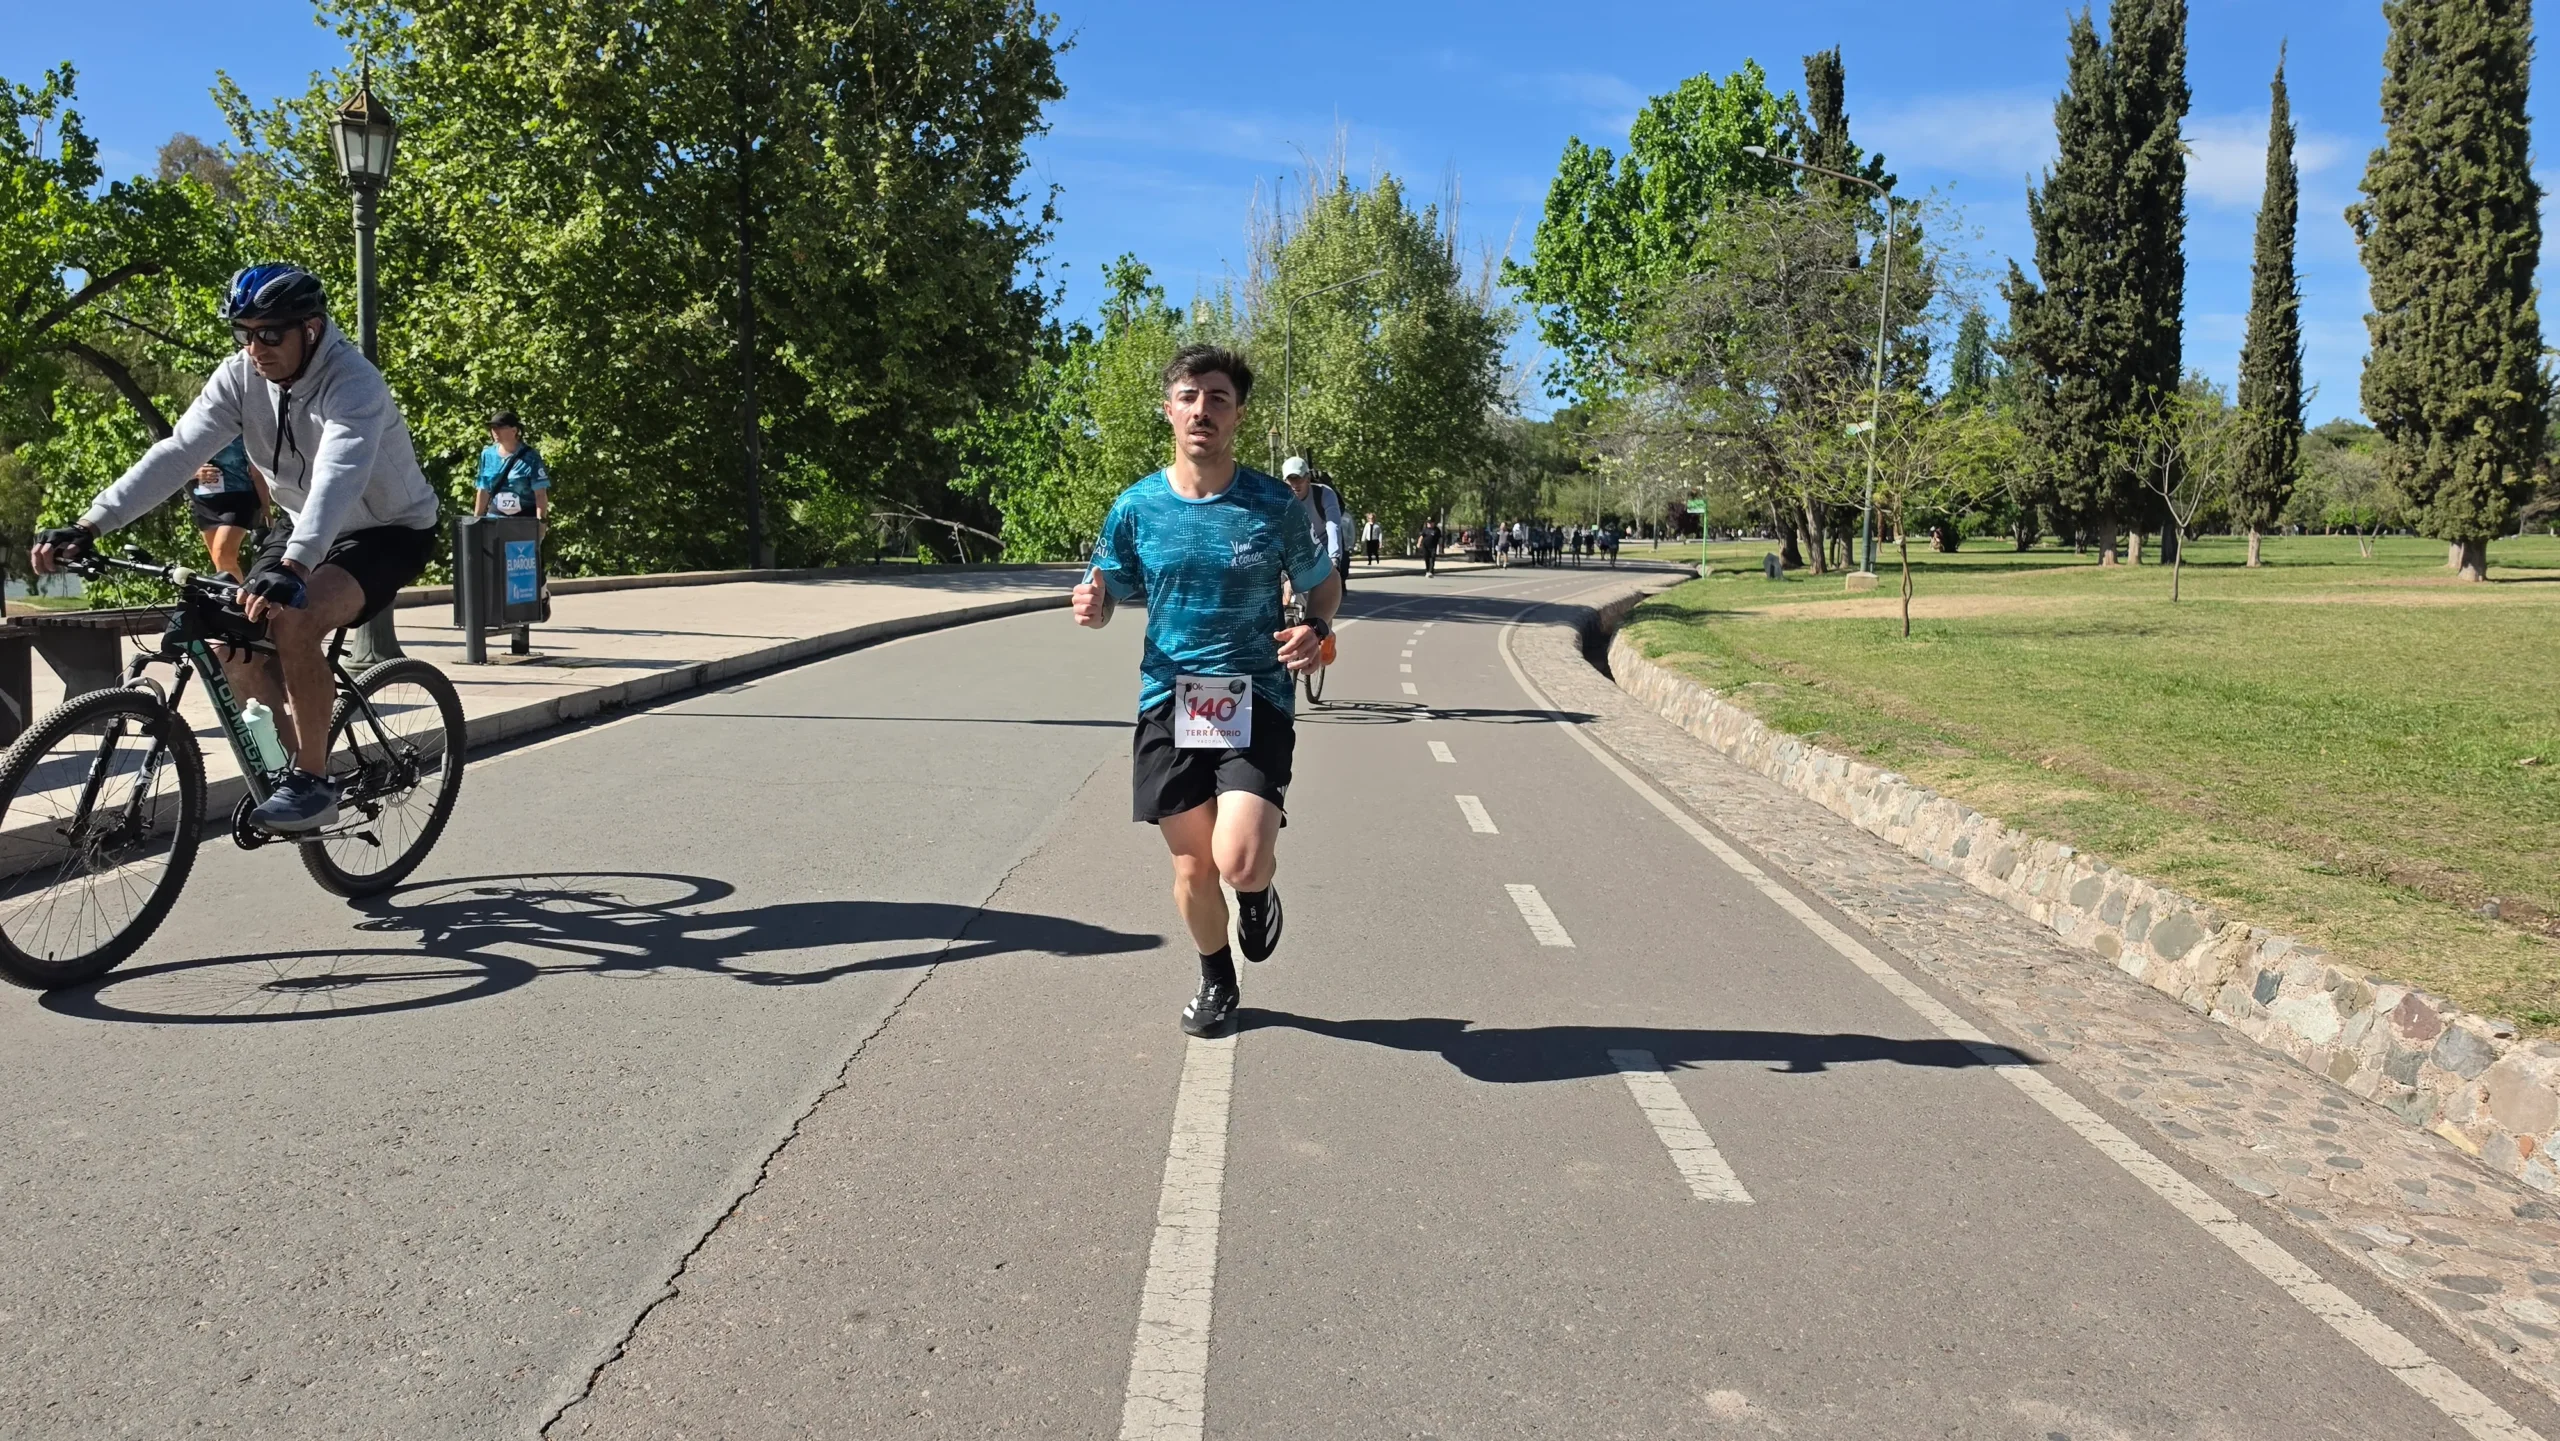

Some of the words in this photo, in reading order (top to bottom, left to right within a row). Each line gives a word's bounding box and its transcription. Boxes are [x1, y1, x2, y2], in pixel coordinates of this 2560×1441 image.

[1188, 682, 1204, 691] 0k
[1187, 696, 1237, 722] 140
[213, 668, 265, 776] TOPMEGA
[1185, 728, 1242, 737] TERRITORIO
